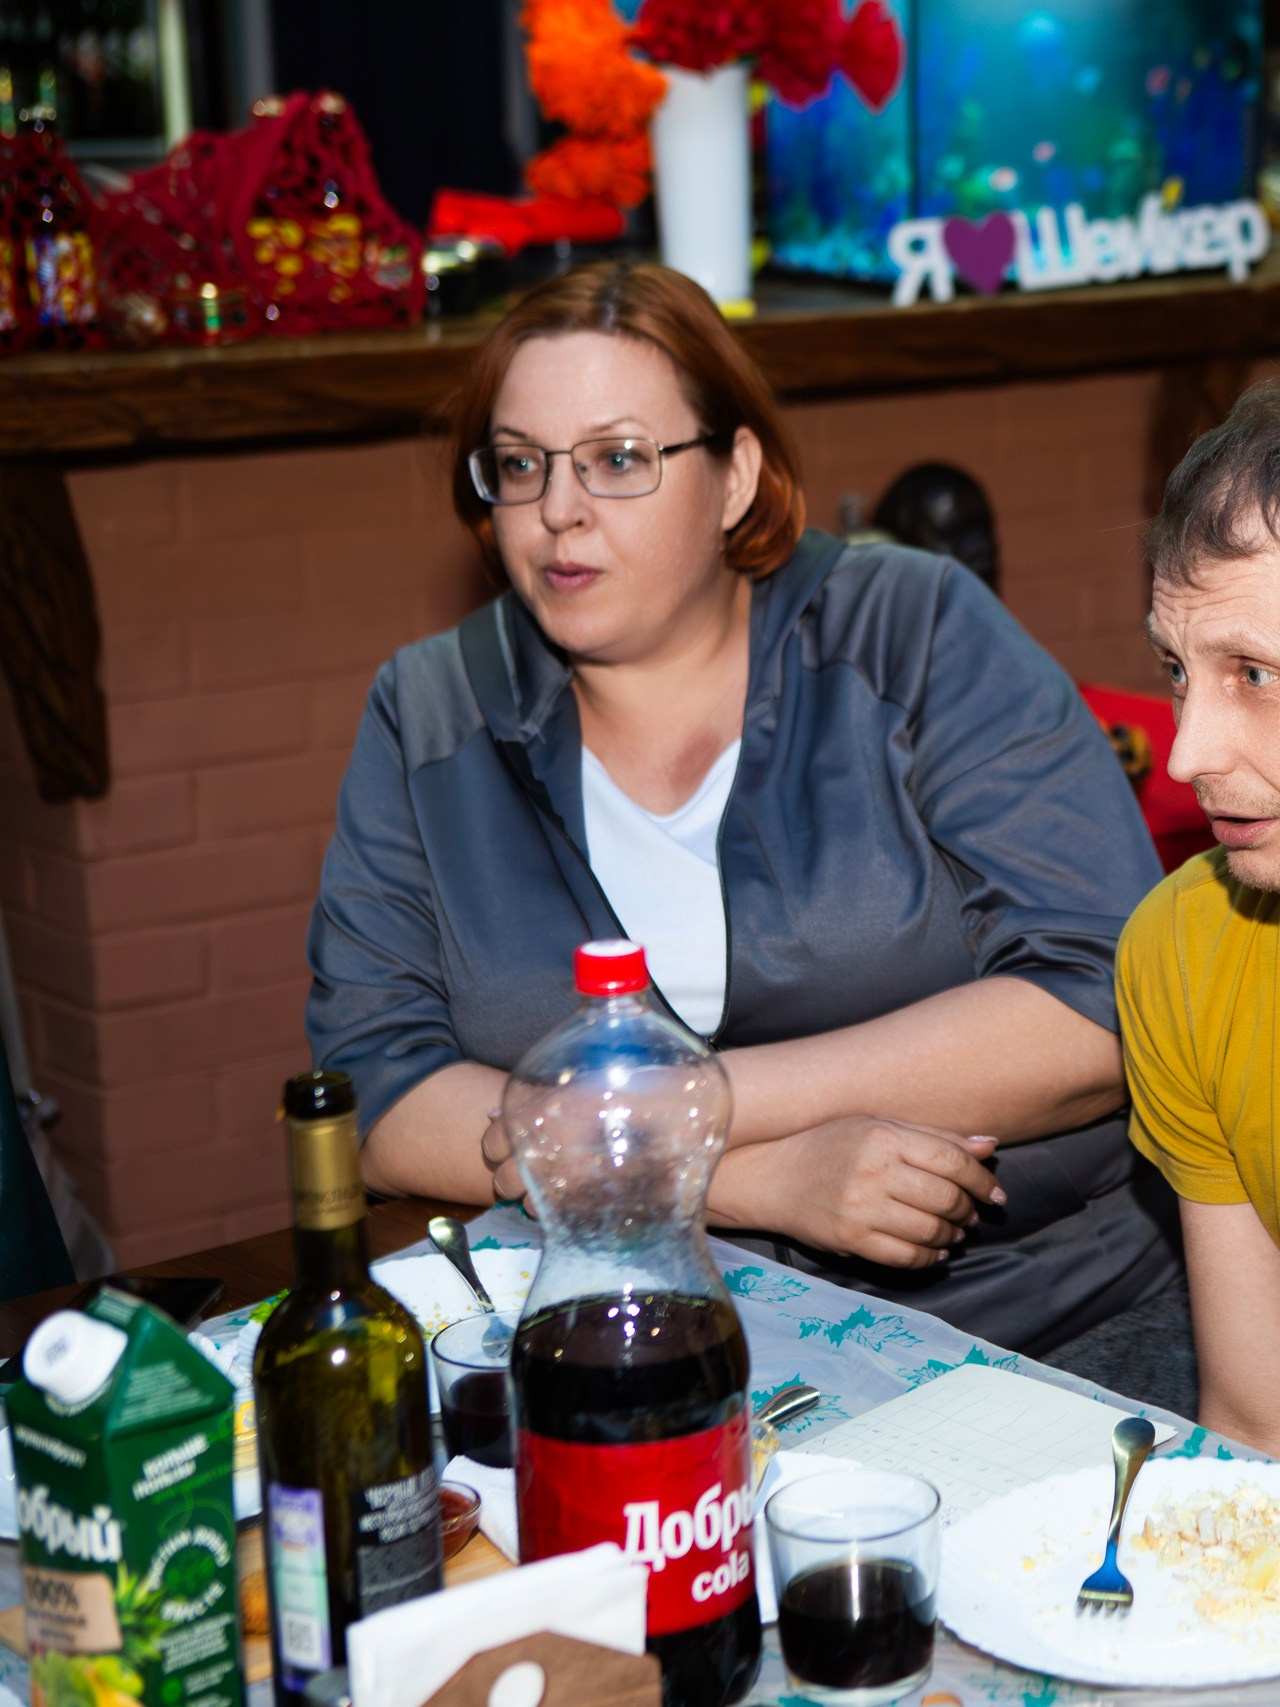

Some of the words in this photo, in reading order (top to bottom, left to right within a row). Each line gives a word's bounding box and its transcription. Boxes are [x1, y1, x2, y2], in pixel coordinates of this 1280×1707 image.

[887, 216, 955, 306] Я
[1009, 192, 1271, 292] Шейкер
[691, 1551, 750, 1603] cola
